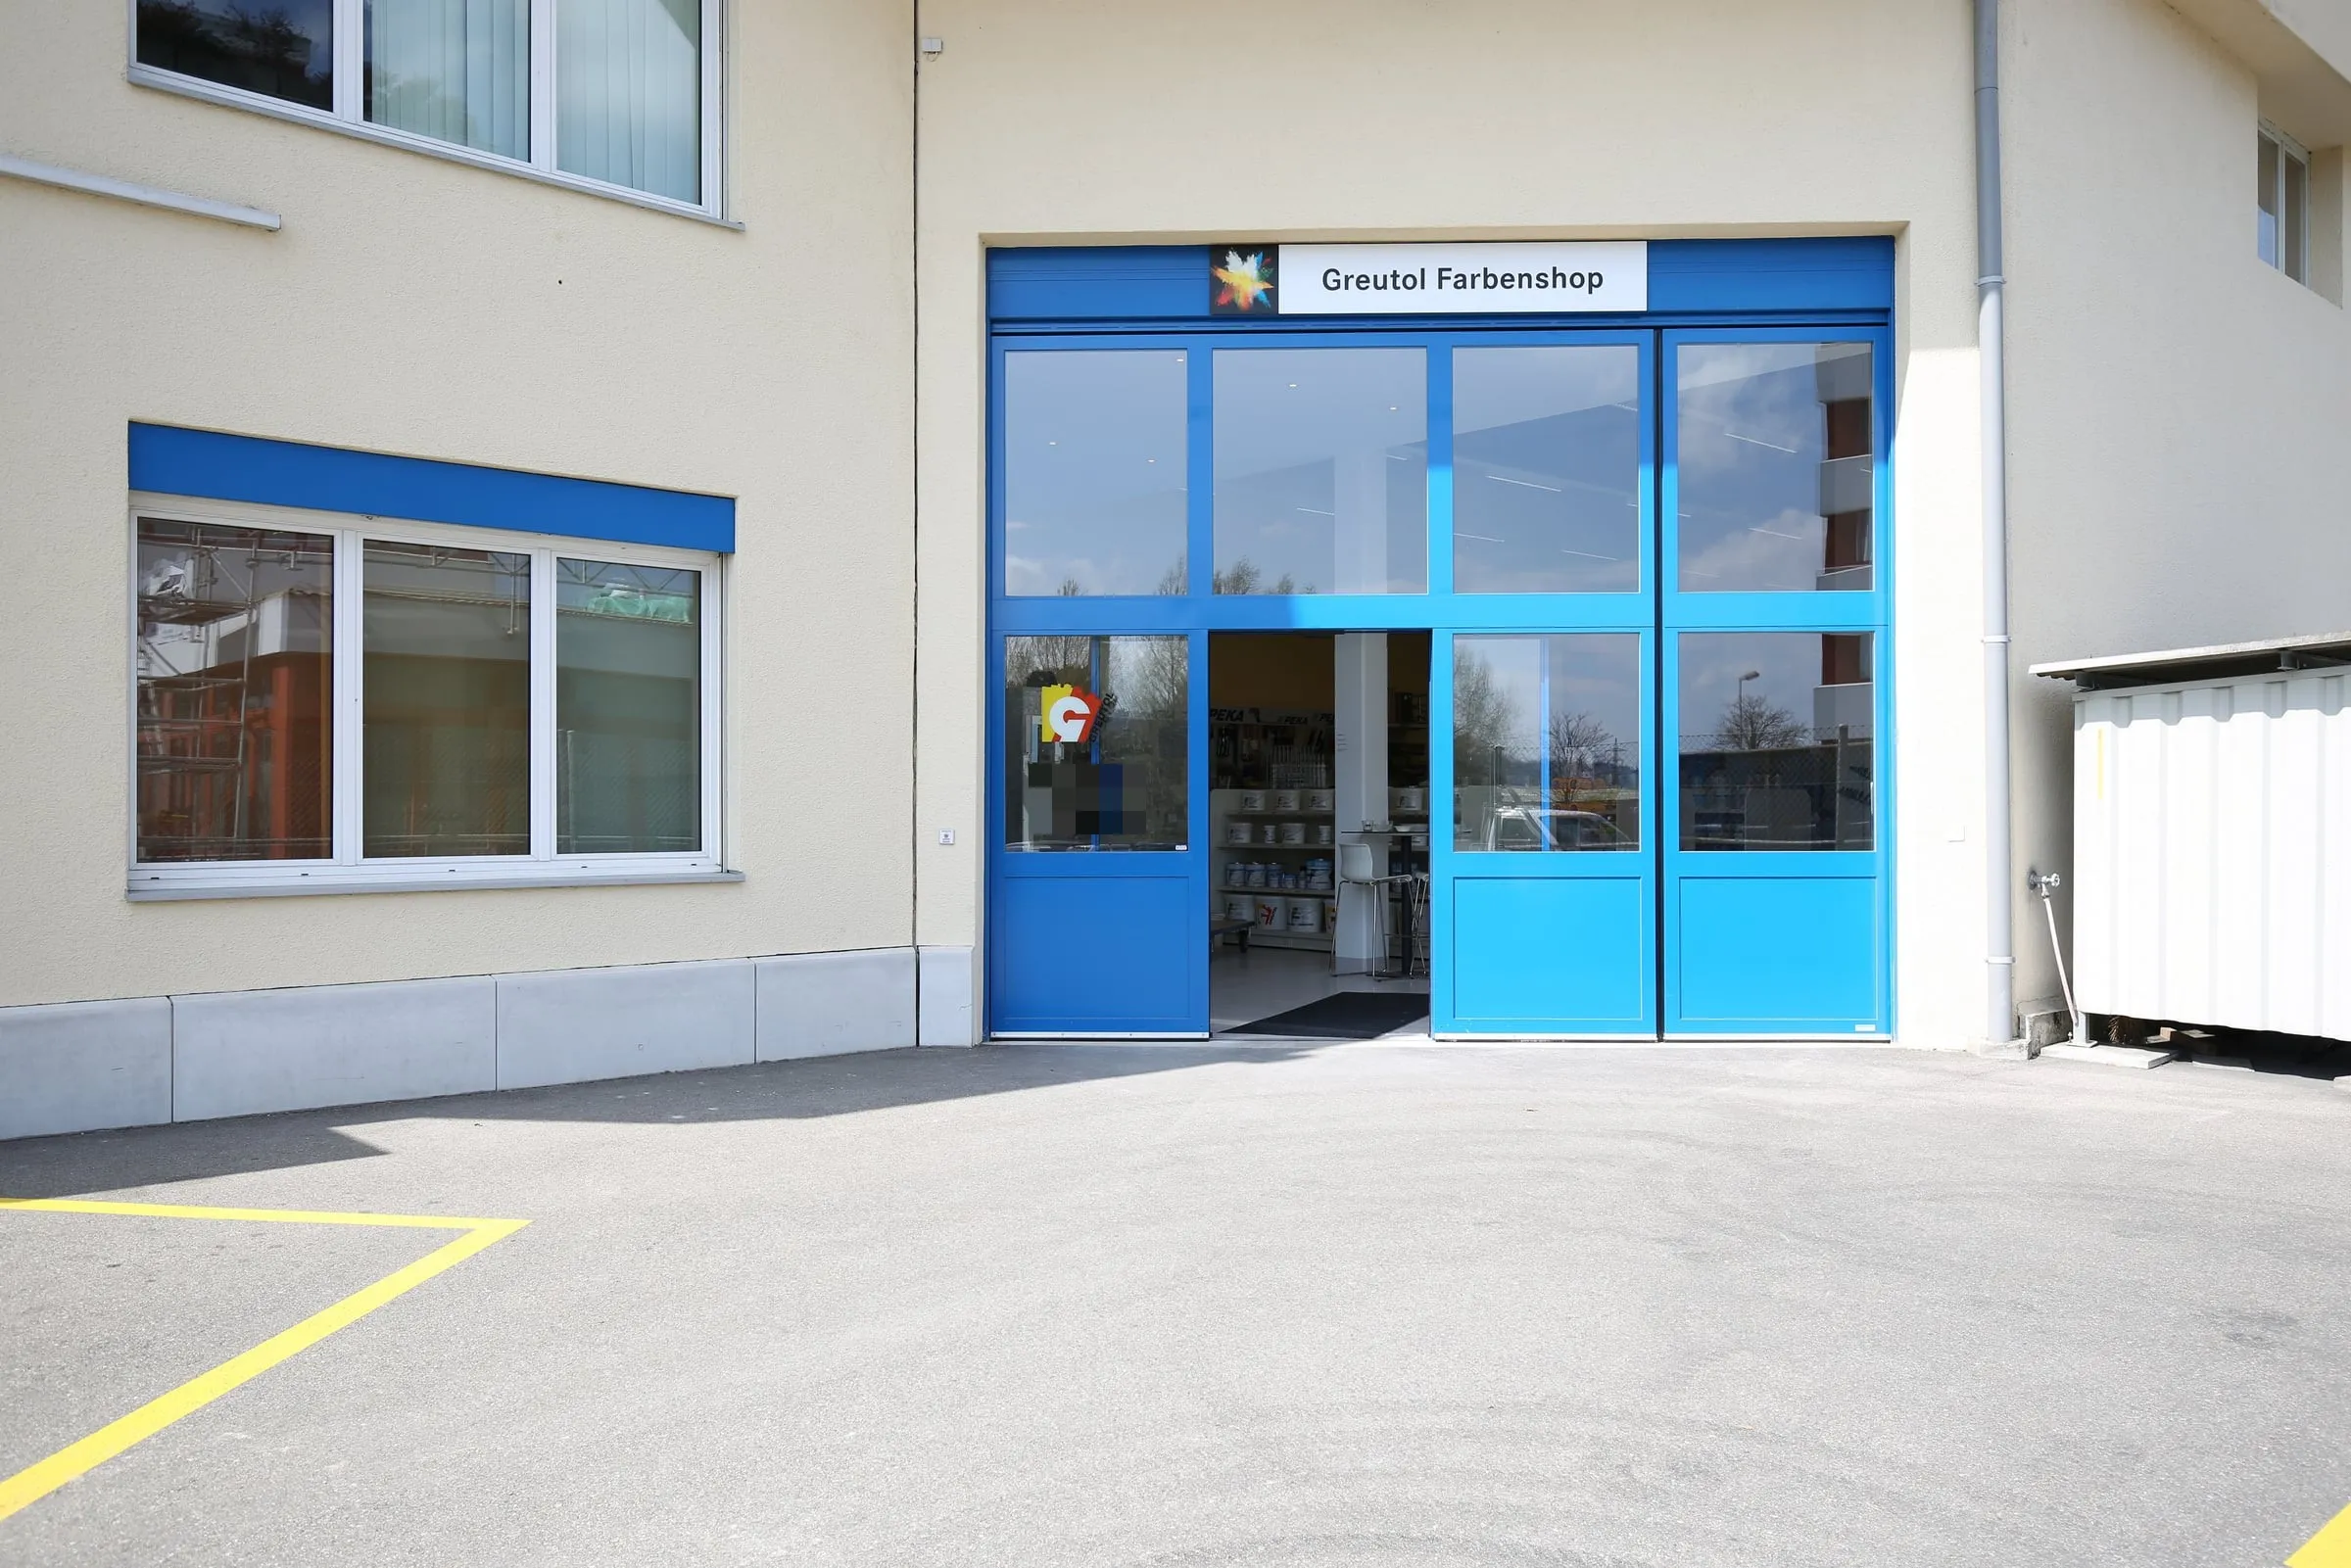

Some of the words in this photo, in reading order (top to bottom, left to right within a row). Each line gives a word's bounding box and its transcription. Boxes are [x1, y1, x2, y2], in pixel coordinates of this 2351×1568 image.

[1322, 267, 1425, 292] Greutol
[1437, 265, 1604, 295] Farbenshop
[1319, 713, 1334, 722] PE
